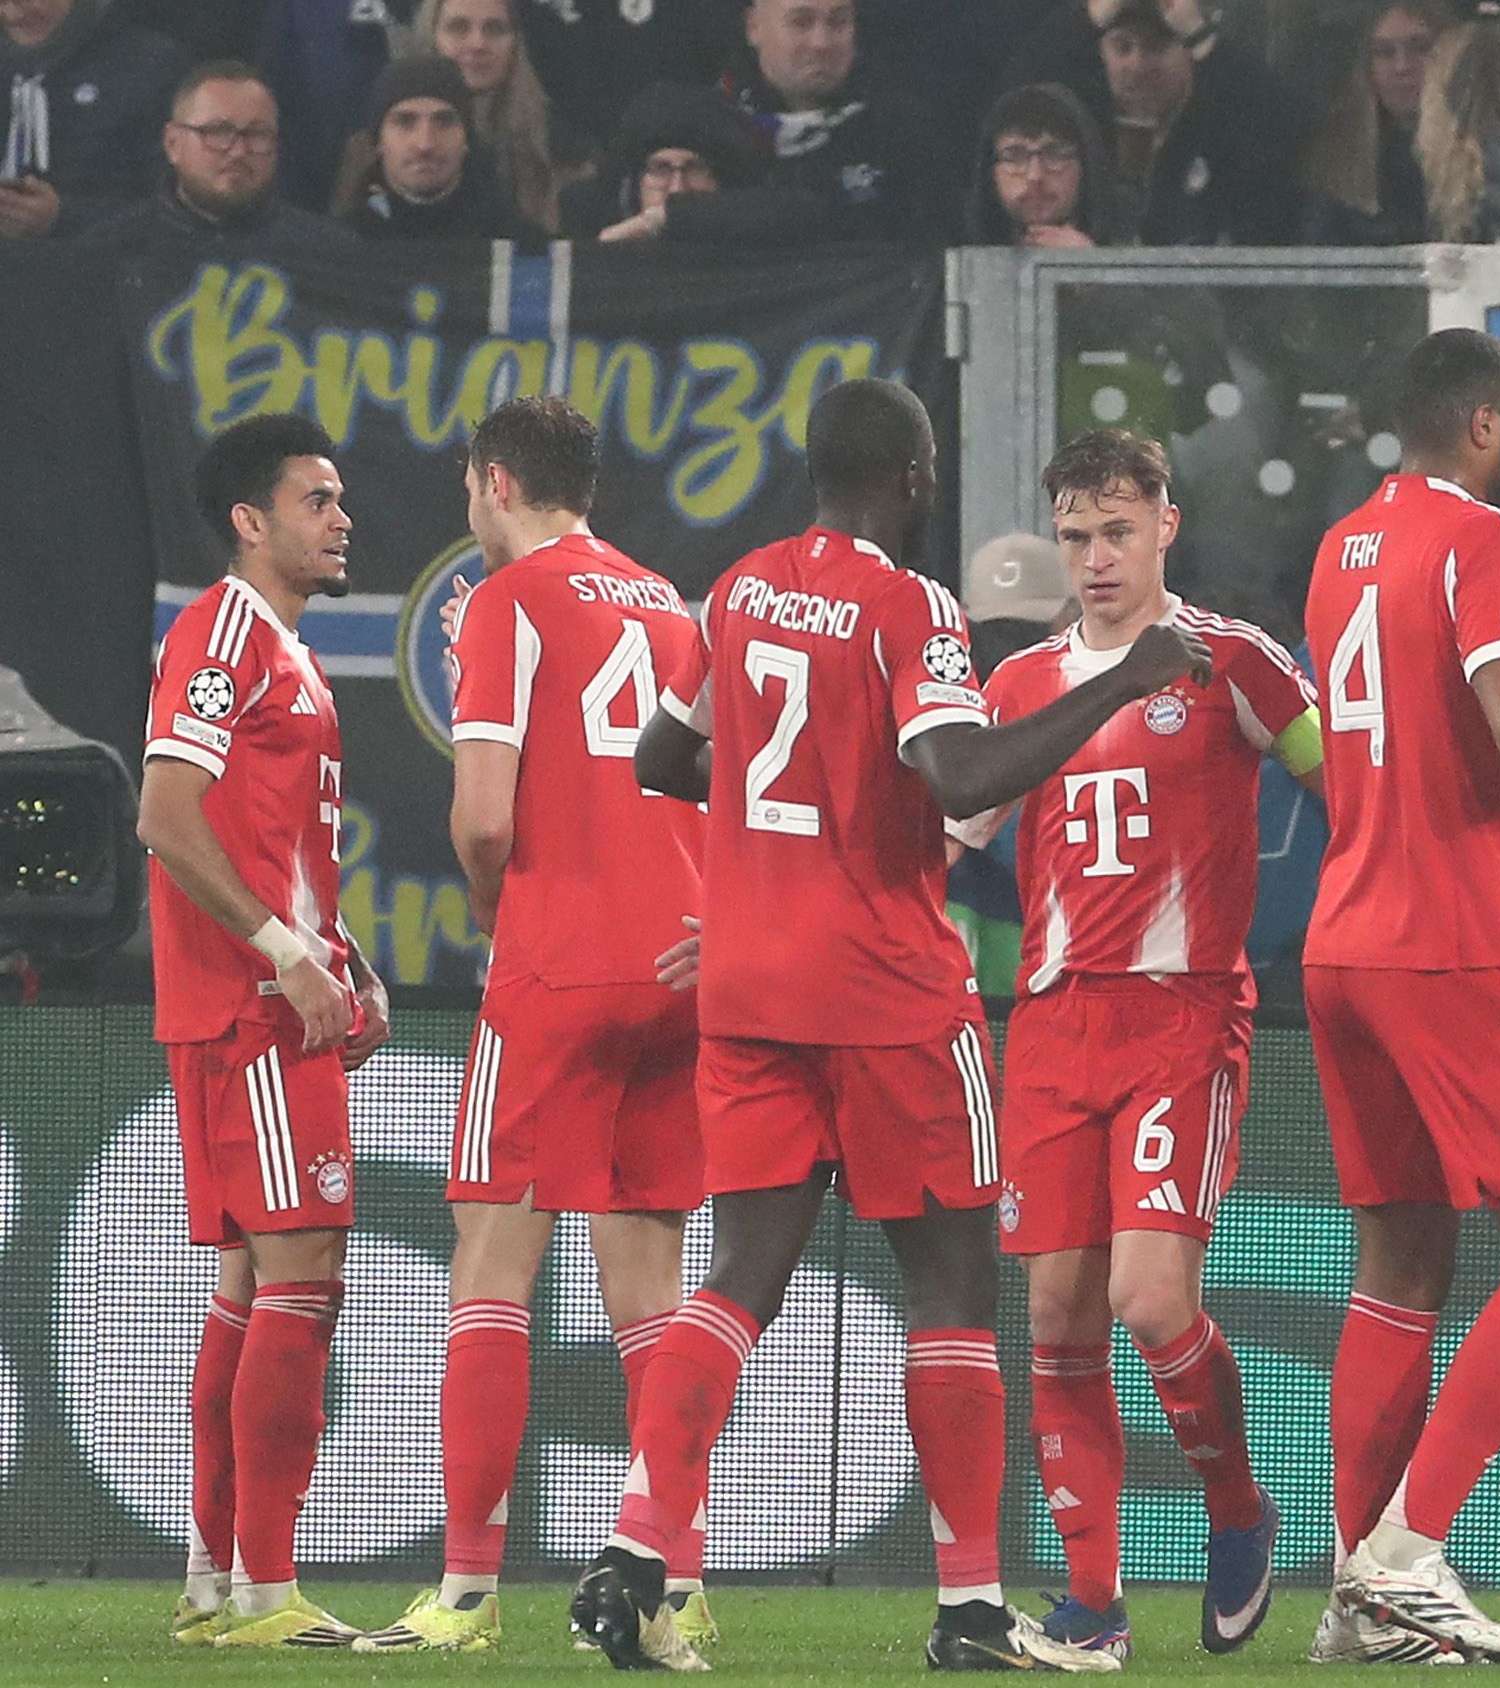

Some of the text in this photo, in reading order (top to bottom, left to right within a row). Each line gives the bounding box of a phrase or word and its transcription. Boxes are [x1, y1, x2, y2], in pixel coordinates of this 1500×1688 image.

[1340, 532, 1383, 570] TAH
[726, 576, 860, 640] UPAMECANO
[1329, 584, 1383, 767] 4
[745, 640, 820, 836] 2
[1132, 1097, 1176, 1173] 6
